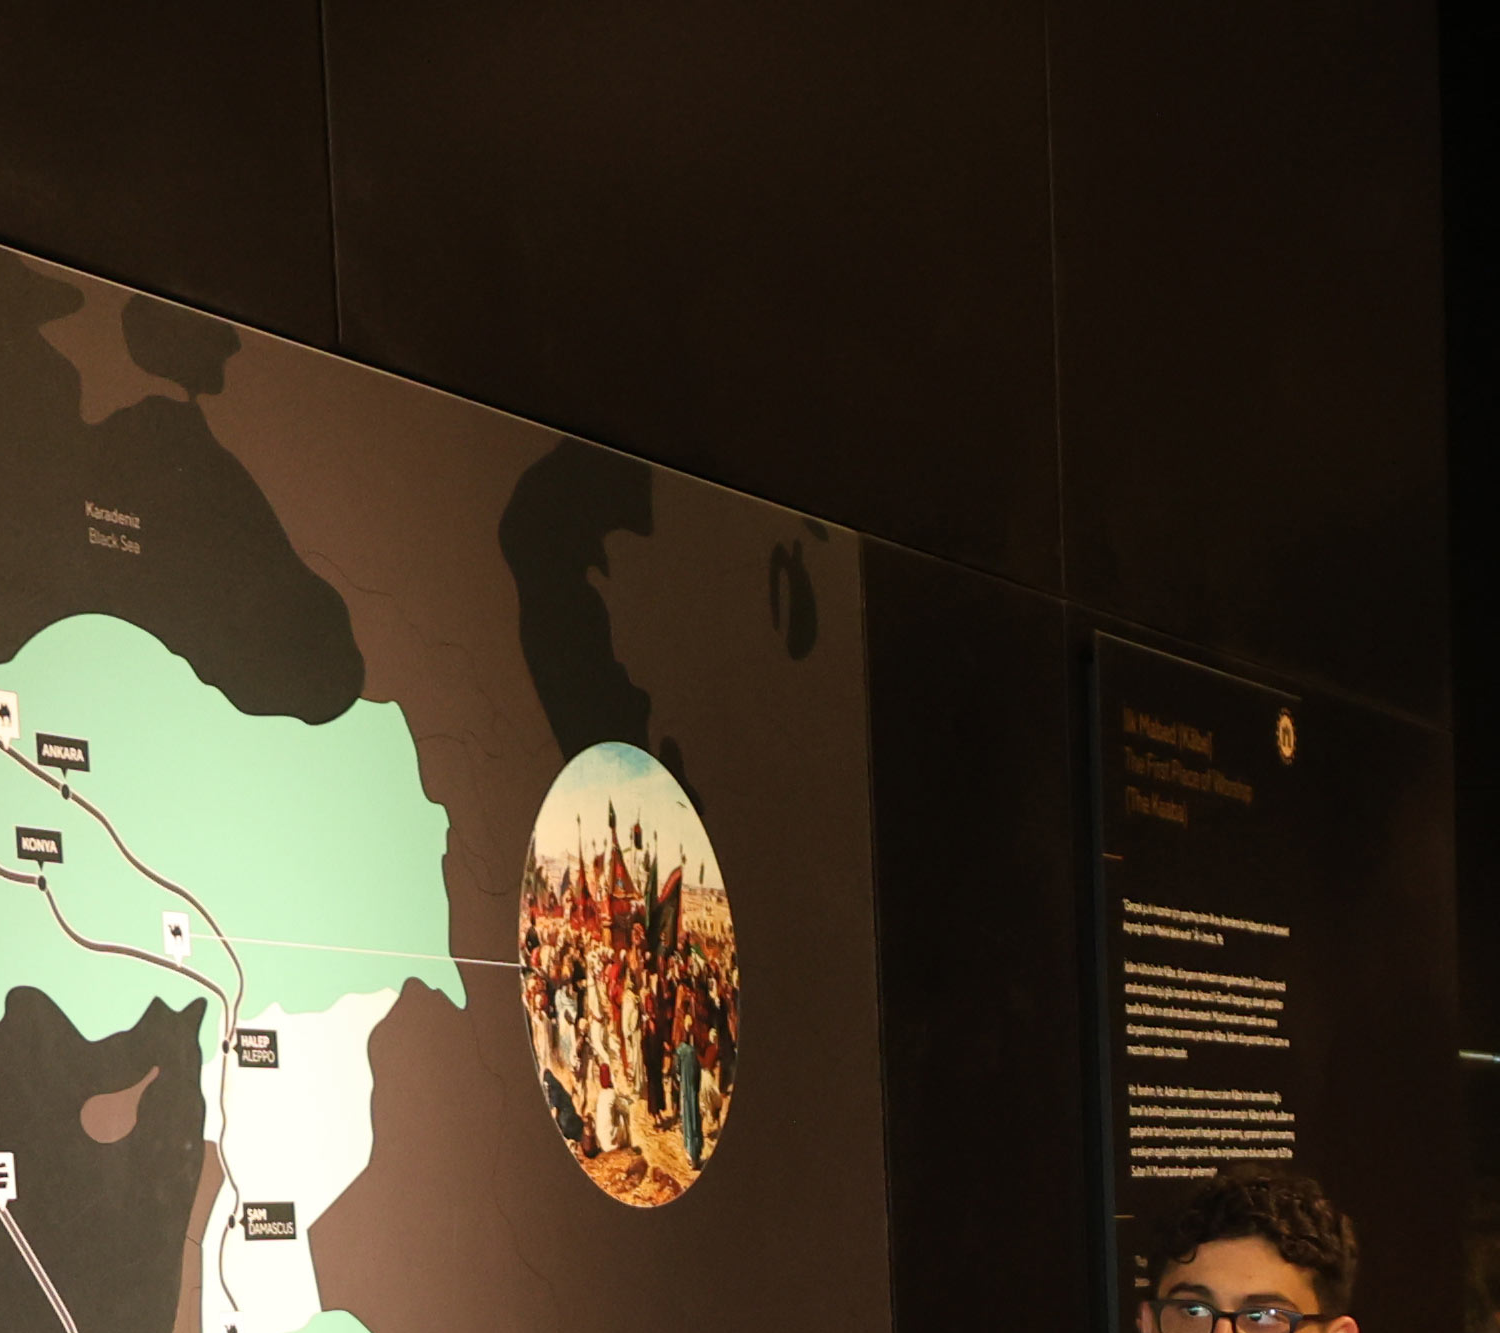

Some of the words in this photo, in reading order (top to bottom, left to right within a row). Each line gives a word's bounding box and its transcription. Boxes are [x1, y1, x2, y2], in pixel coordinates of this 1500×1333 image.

[41, 743, 85, 762] ANKARA
[21, 836, 59, 854] KONYA
[240, 1035, 270, 1048] HALEP
[241, 1049, 276, 1064] ALEPPO
[248, 1221, 294, 1236] DAMASCUS
